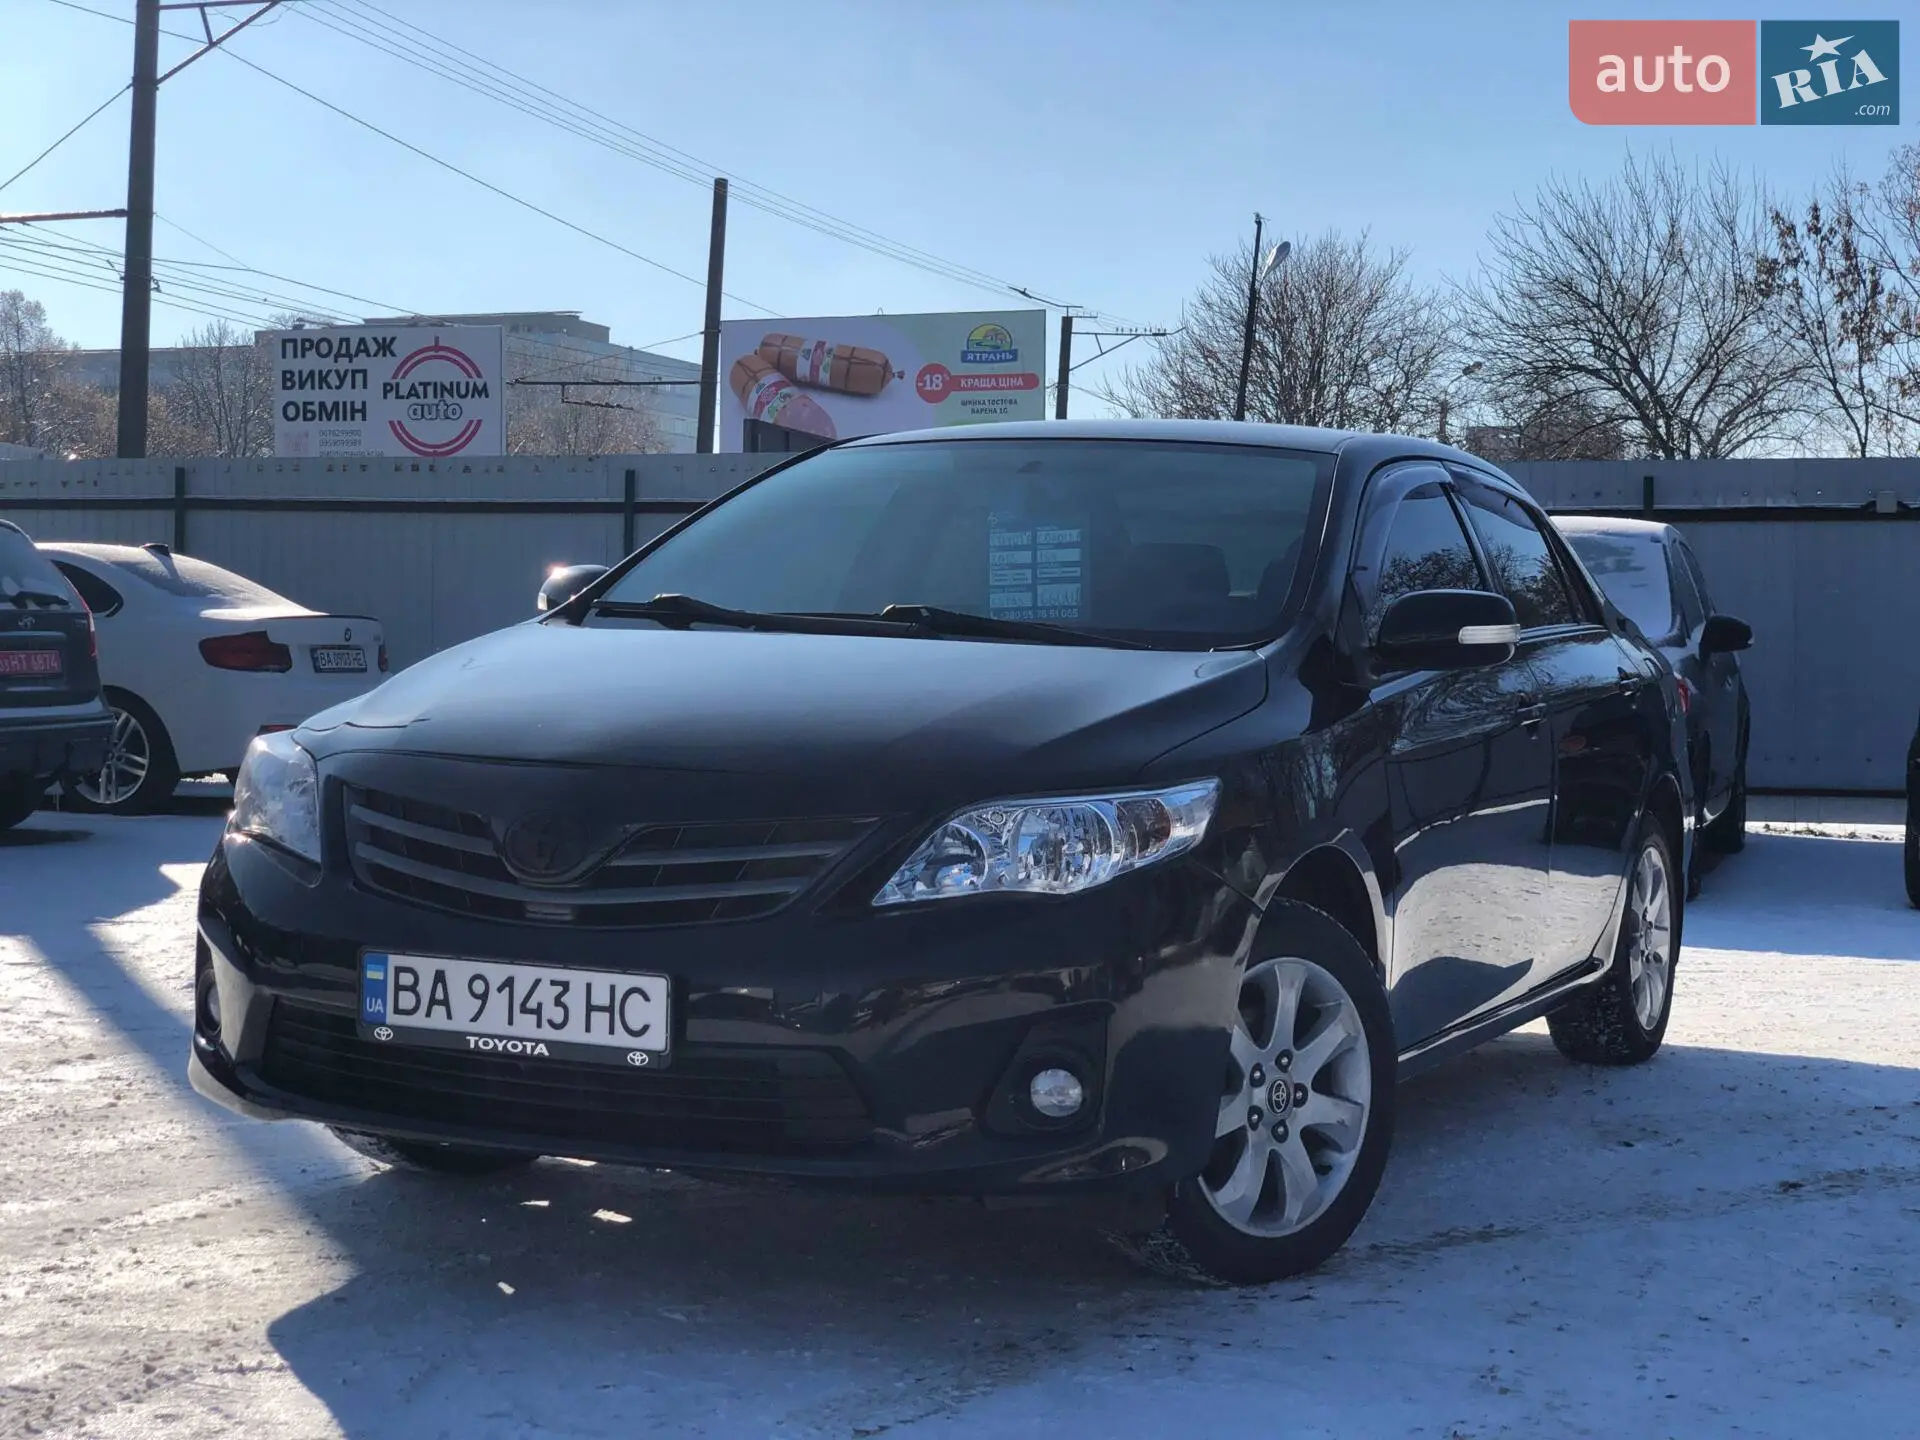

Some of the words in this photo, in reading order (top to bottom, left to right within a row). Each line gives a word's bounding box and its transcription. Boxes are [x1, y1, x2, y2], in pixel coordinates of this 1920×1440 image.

[281, 336, 397, 363] ПРОДАЖ
[966, 352, 1014, 361] ЯТРАНЬ
[281, 368, 368, 391] ВИКУП
[998, 376, 1024, 389] ЦІНА
[382, 381, 490, 400] PLATINUM
[282, 400, 367, 422] ОБМІН
[407, 400, 463, 421] auto
[366, 997, 384, 1014] UA
[393, 966, 452, 1020] BA
[467, 974, 570, 1031] 9143
[585, 982, 651, 1038] HC
[466, 1036, 549, 1057] TOYOTA
